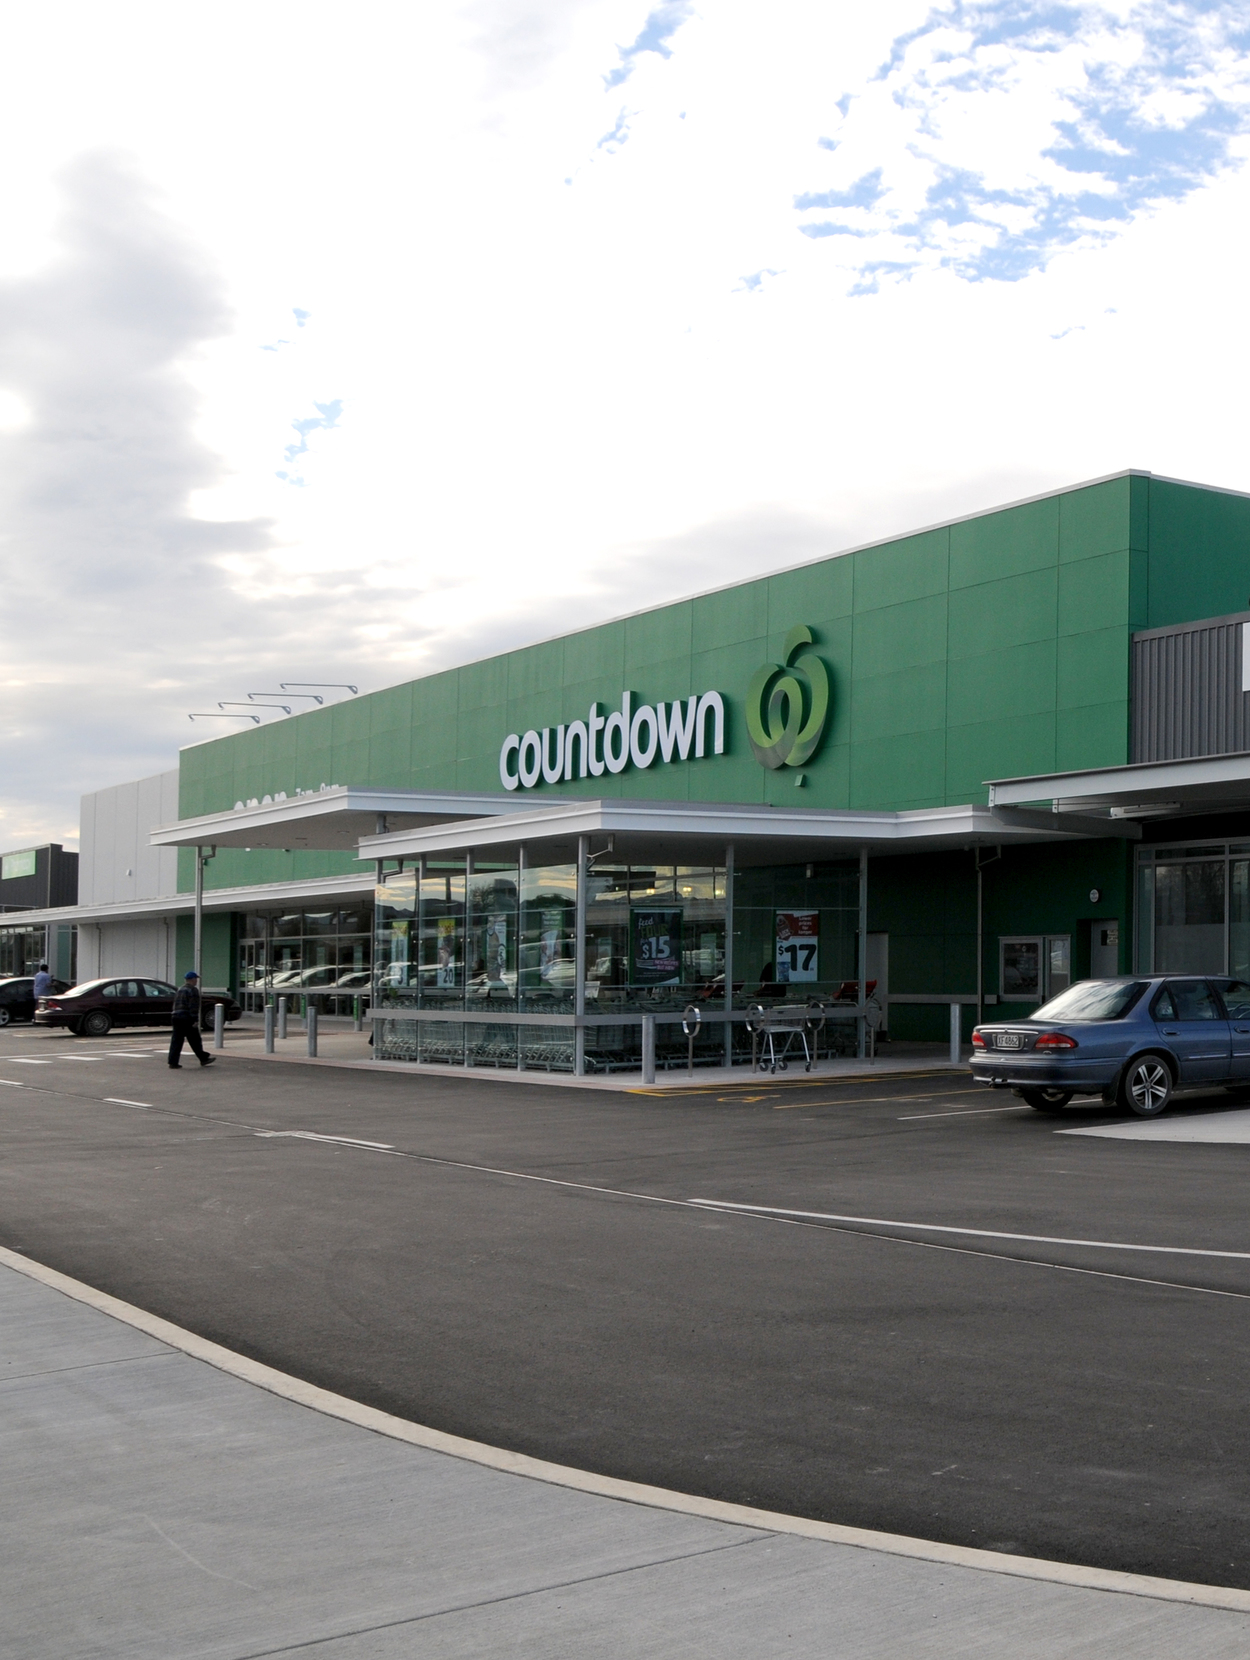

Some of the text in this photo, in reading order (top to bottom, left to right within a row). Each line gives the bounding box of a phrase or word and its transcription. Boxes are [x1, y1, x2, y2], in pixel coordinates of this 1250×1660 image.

[500, 690, 725, 791] countdown
[642, 936, 670, 959] $15
[778, 944, 816, 971] $17
